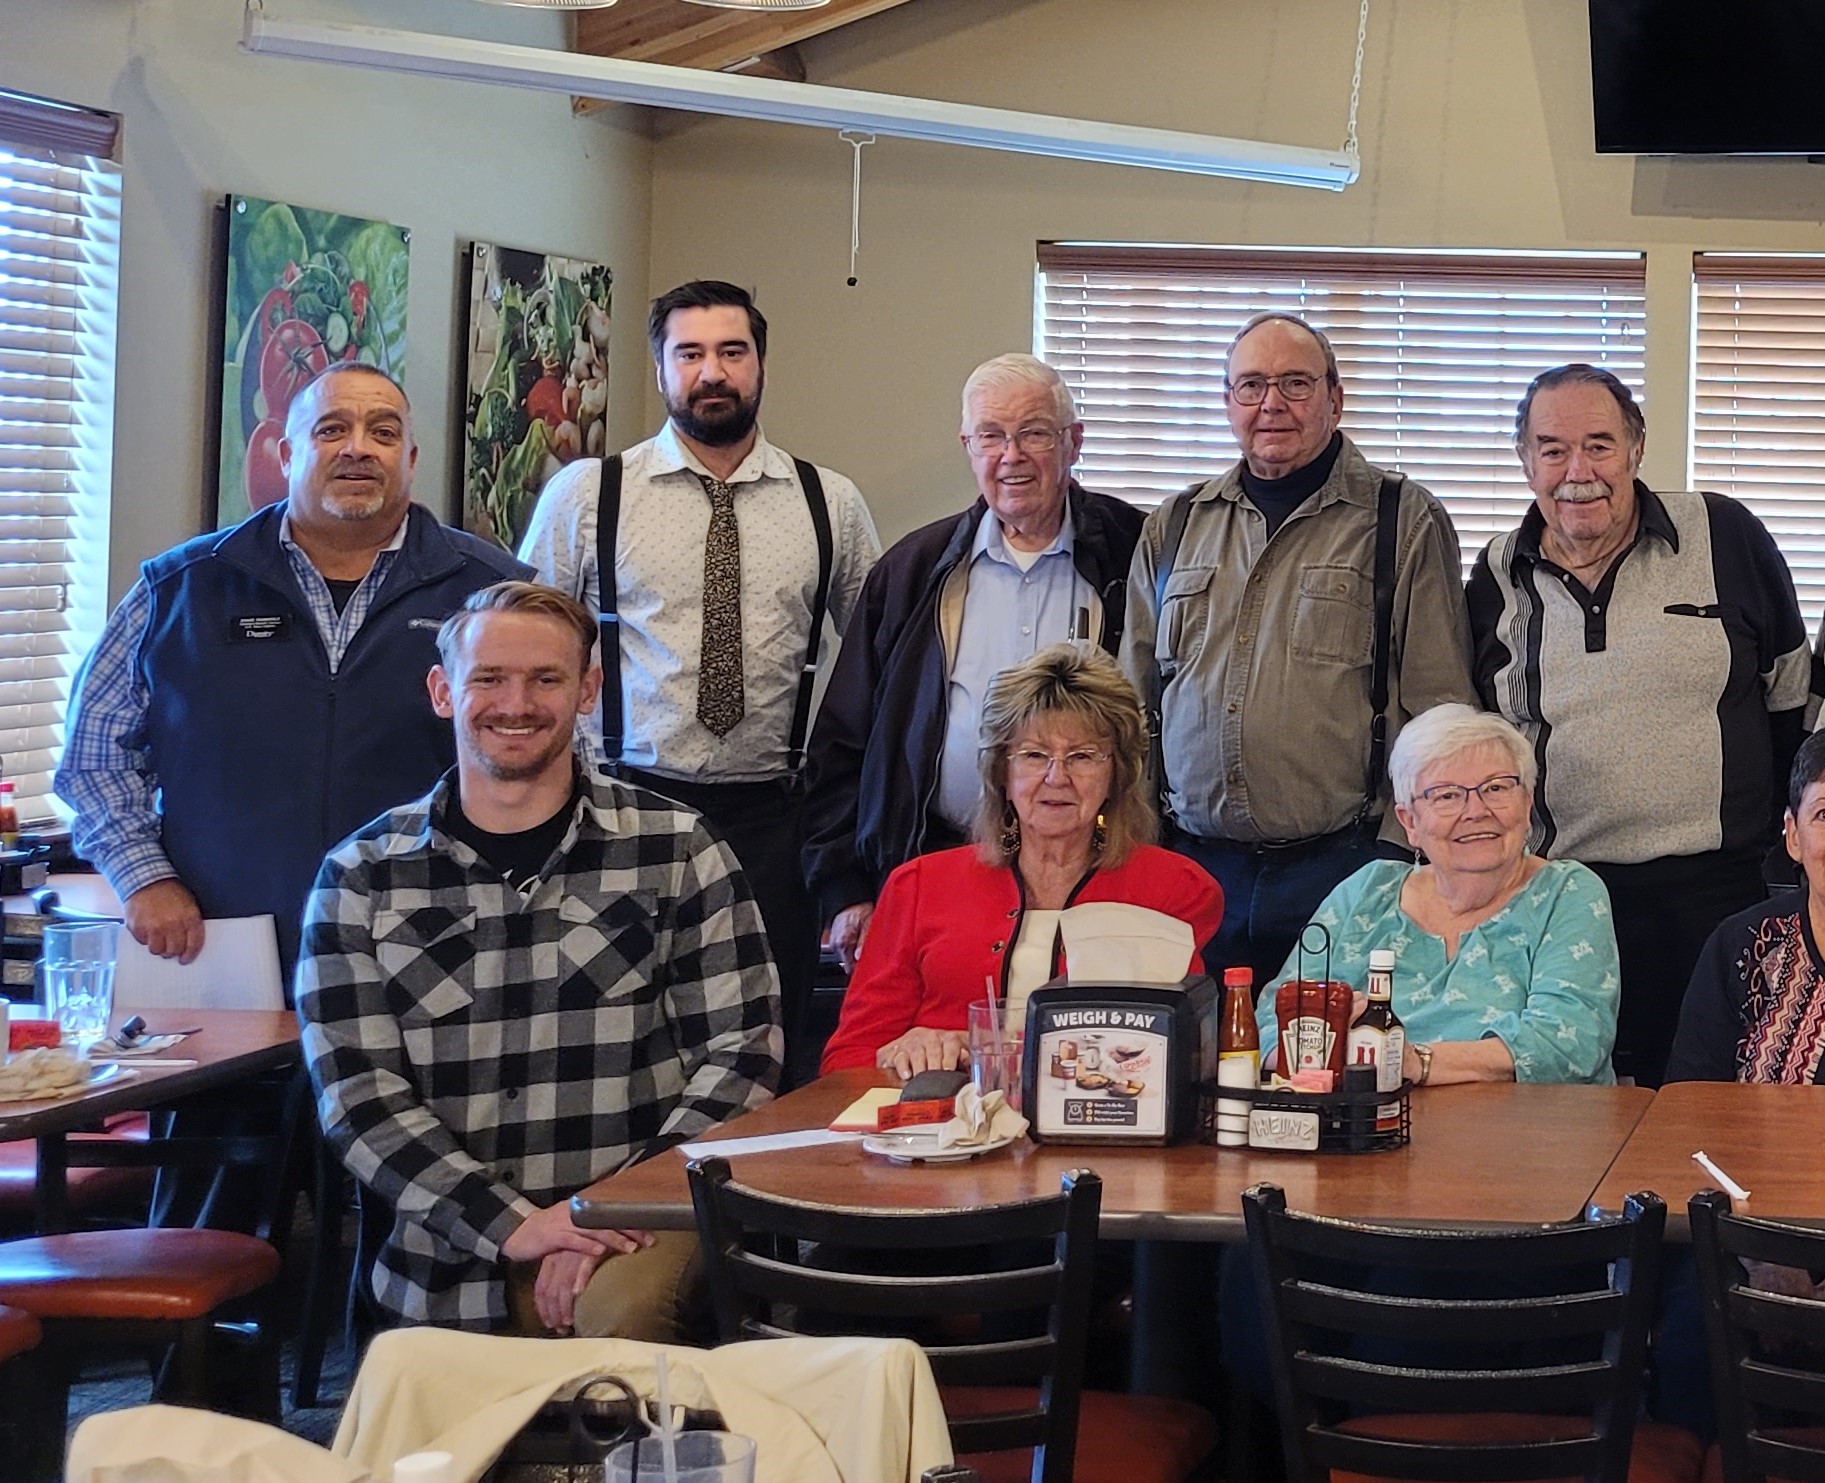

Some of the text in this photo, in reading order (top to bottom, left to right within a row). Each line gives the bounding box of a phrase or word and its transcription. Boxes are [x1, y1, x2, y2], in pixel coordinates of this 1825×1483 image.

[1052, 1010, 1156, 1029] WEIGH & PAY
[1299, 1037, 1323, 1045] OMATO
[1253, 1116, 1314, 1141] HEINZ
